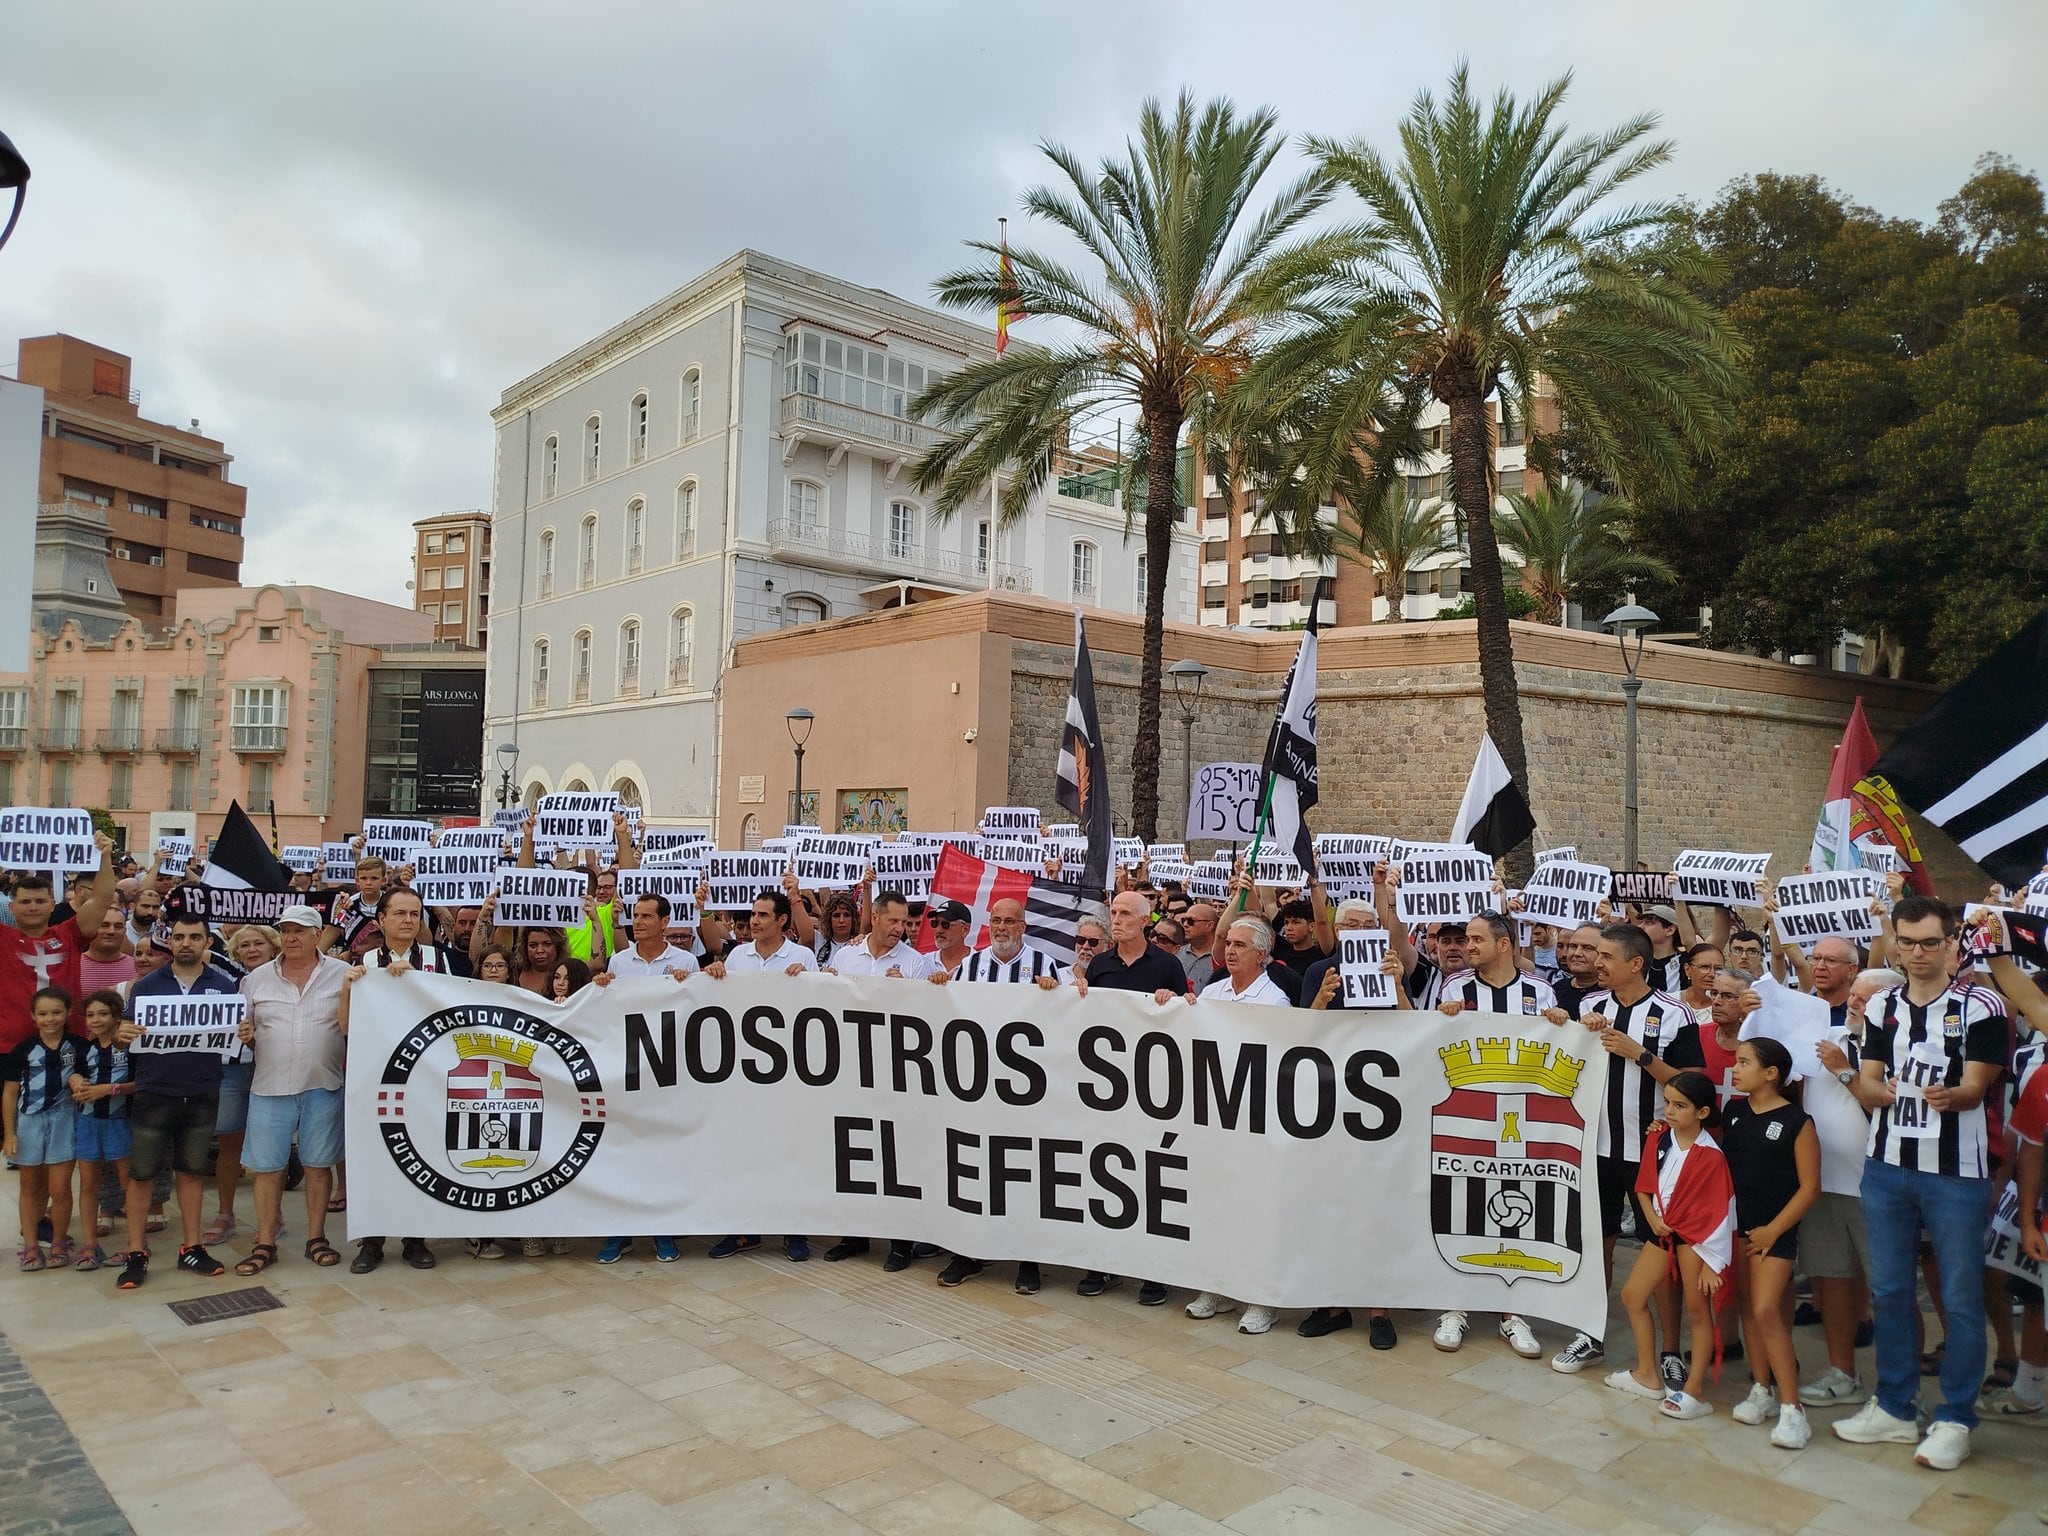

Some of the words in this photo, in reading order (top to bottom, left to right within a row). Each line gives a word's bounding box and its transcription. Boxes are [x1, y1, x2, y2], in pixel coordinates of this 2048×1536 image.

[423, 690, 442, 700] ARS
[444, 690, 479, 700] LONGA
[538, 796, 617, 813] ¡BELMONTE
[1, 813, 95, 836] BELMONT
[540, 817, 584, 836] VENDE
[587, 818, 608, 837] YA!
[1051, 827, 1079, 838] MONTE
[437, 833, 505, 849] ¡BELMONTE
[796, 838, 870, 858] ¡BELMONTE
[0, 842, 60, 865] VENDE
[65, 843, 93, 865] YA!
[366, 846, 406, 862] VENDE
[872, 853, 940, 873] ¡BELMONT
[979, 844, 1047, 863] ¡BELMONTE
[326, 867, 356, 880] VEND
[705, 858, 788, 882] ¡BELMONTE
[797, 860, 840, 880] VENDE
[843, 862, 863, 881] YA!
[1286, 863, 1304, 882] YA!
[1322, 860, 1362, 877] VENDE
[1675, 854, 1767, 874] ¡BELMONTE
[496, 875, 587, 899] ¡BELMONTE
[618, 876, 699, 896] ¡BELMONTE
[1063, 869, 1084, 886] VEN
[416, 882, 465, 901] VENDE
[468, 881, 491, 900] YA!
[710, 885, 757, 905] VENDE
[1191, 882, 1220, 897] VENDE
[1678, 876, 1730, 898] VENDE
[1731, 879, 1757, 901] YA!
[183, 887, 207, 915] FC
[1403, 892, 1462, 916] VENDE
[1464, 891, 1492, 914] YA!
[1525, 894, 1568, 918] VENDE
[1572, 899, 1597, 921] YA!
[500, 902, 551, 921] VENDE
[555, 904, 579, 923] YA!
[673, 902, 694, 922] YA!
[1780, 911, 1842, 938] VENDE
[1841, 907, 1873, 932] YA!
[1345, 973, 1357, 999] E
[1358, 973, 1387, 998] YA!
[140, 1033, 203, 1050] VENDE
[205, 1032, 236, 1049] YA!
[393, 1009, 504, 1073] FEDERACION
[512, 1015, 540, 1038] DE
[543, 1031, 592, 1083] PEÑAS
[625, 1005, 1048, 1107] NOSOTROS
[1077, 1025, 1402, 1142] SOMOS
[450, 1100, 470, 1112] F.C.
[472, 1100, 540, 1112] CARTAGENA
[387, 1130, 438, 1194] FUTBOL
[445, 1185, 497, 1209] CLUB
[506, 1130, 598, 1207] CARTAGENA
[833, 1115, 924, 1201] EL
[945, 1126, 1191, 1243] EFESÉ
[1437, 1156, 1469, 1173] F.C.
[1473, 1160, 1578, 1187] CARTAGENA
